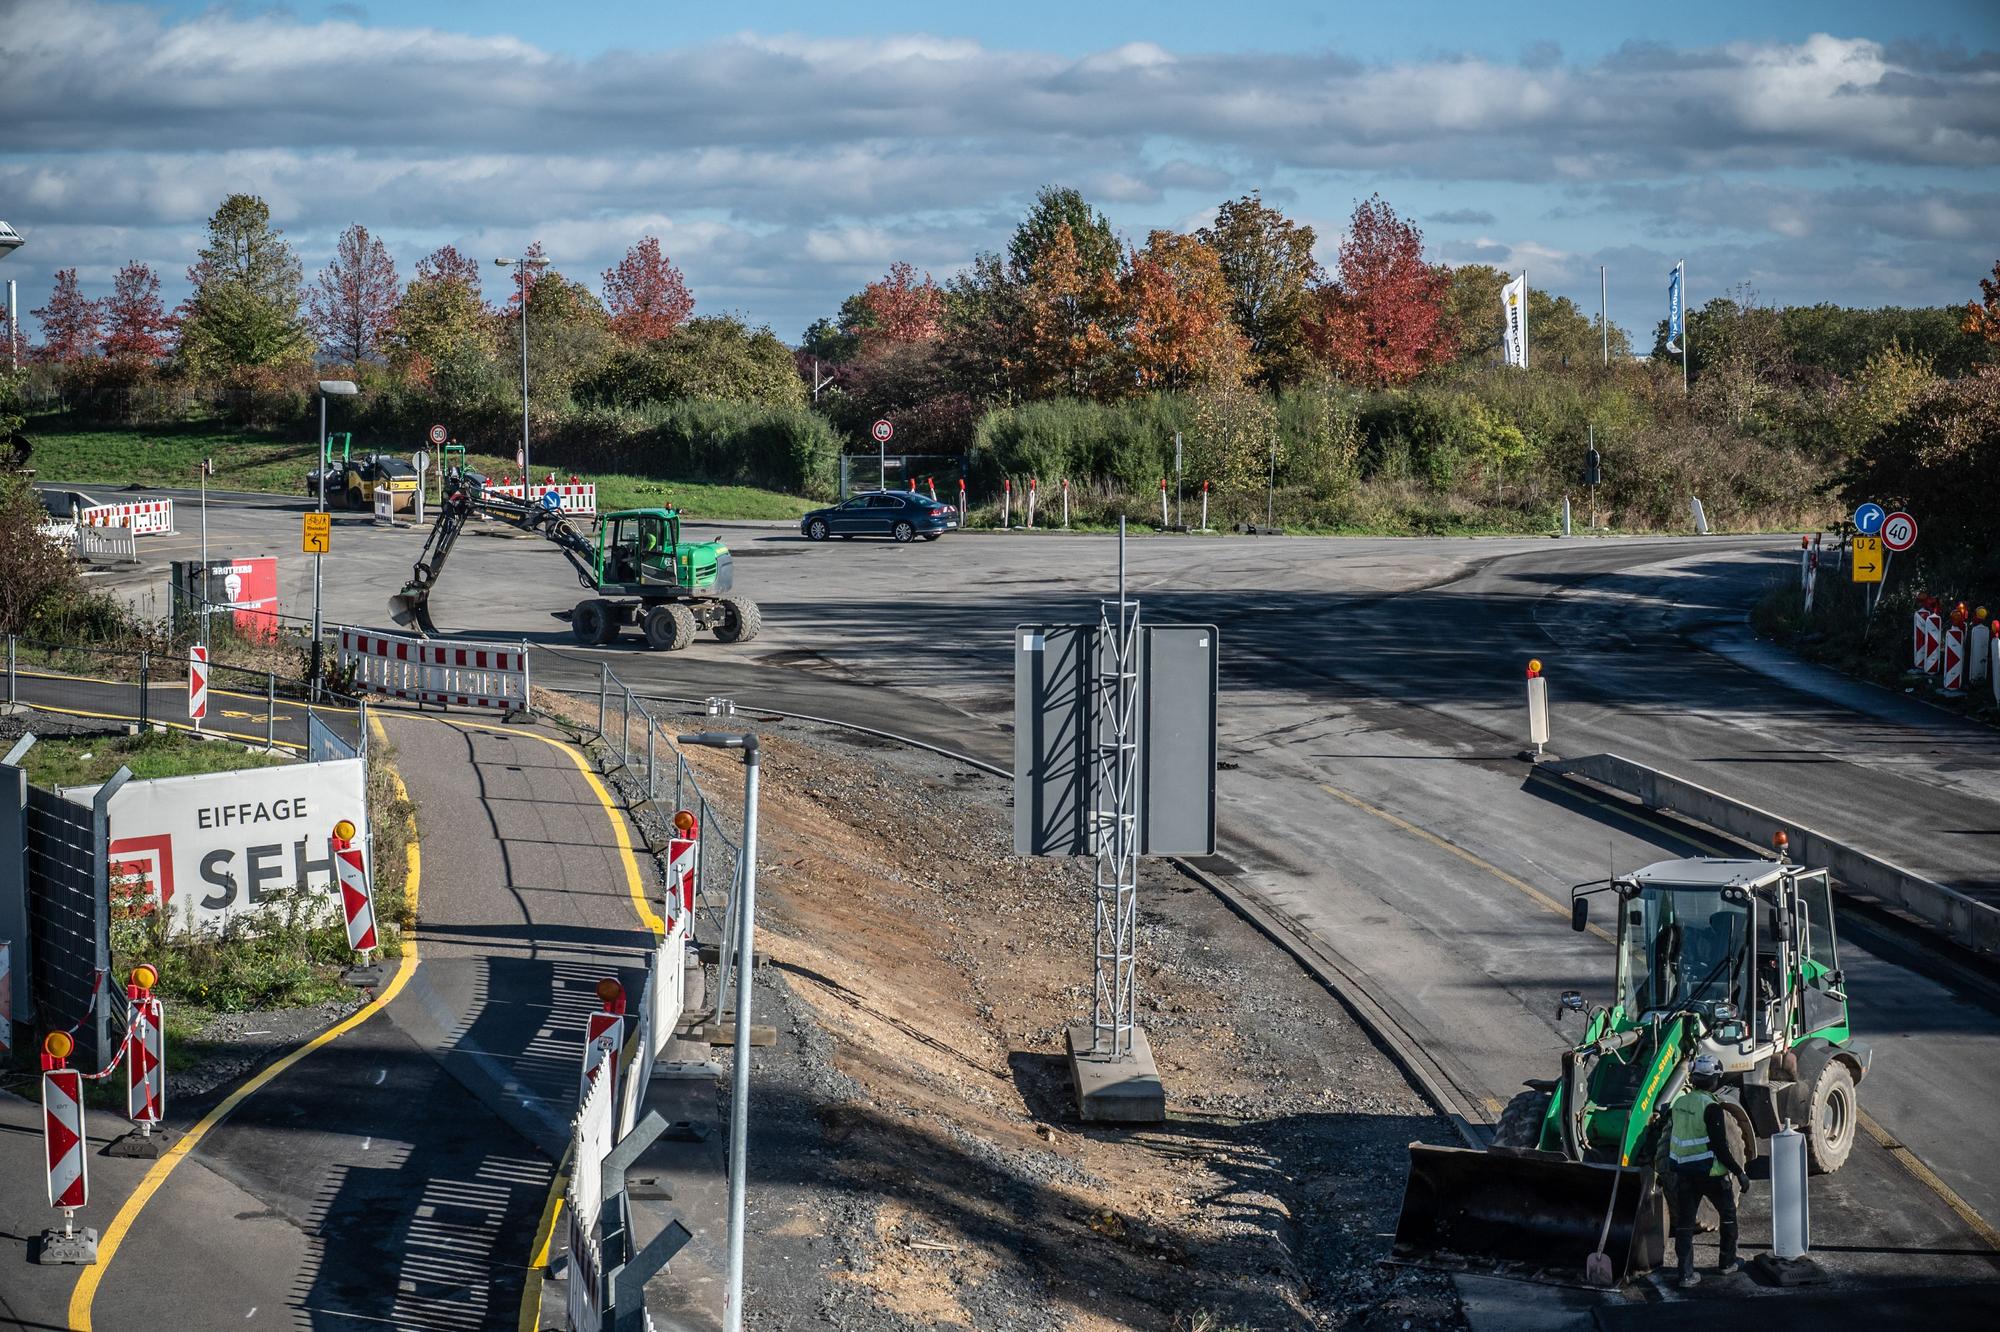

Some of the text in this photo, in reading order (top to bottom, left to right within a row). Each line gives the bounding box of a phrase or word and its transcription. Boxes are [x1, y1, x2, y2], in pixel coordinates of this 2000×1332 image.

[434, 430, 443, 438] 50
[1888, 523, 1908, 541] 40
[1856, 538, 1876, 550] U 2
[212, 564, 253, 576] BROTHERS
[198, 797, 308, 830] EIFFAGE
[199, 836, 341, 910] SEH
[1641, 1043, 1674, 1112] Dr. Fink-Stauf
